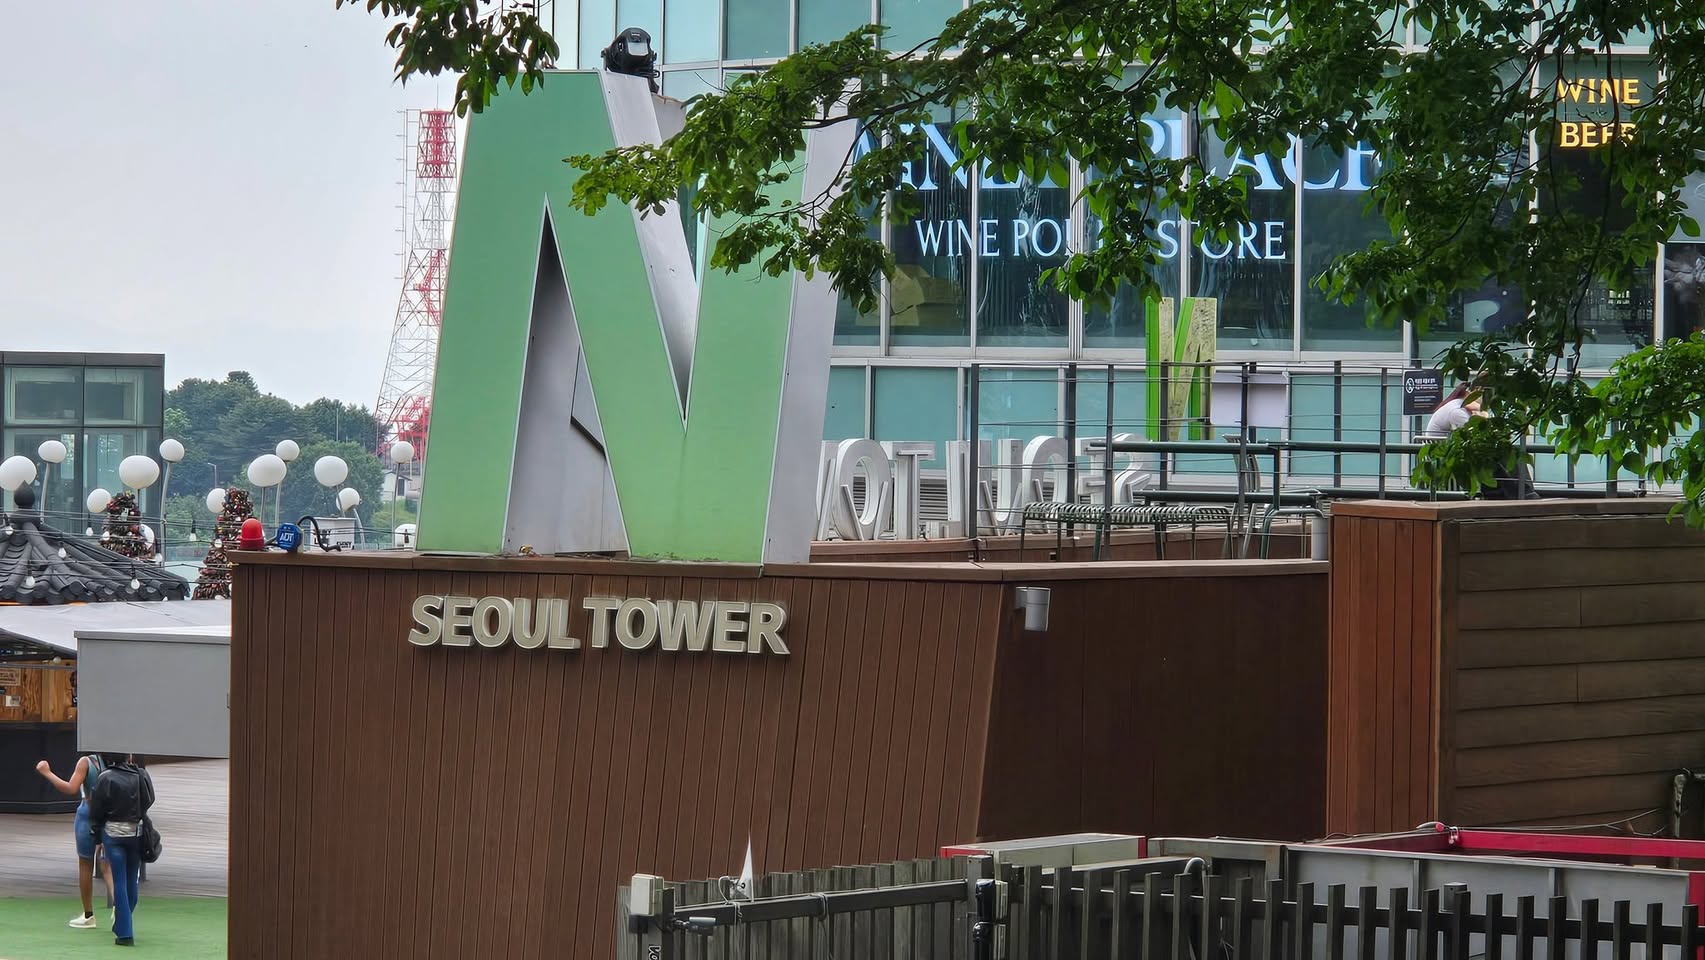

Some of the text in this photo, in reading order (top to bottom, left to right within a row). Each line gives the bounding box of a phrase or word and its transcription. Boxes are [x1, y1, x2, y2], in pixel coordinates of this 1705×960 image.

[1555, 78, 1641, 105] WINE
[915, 219, 1000, 257] WINE
[279, 532, 295, 542] ADT
[408, 594, 791, 655] SEOUL TOWER
